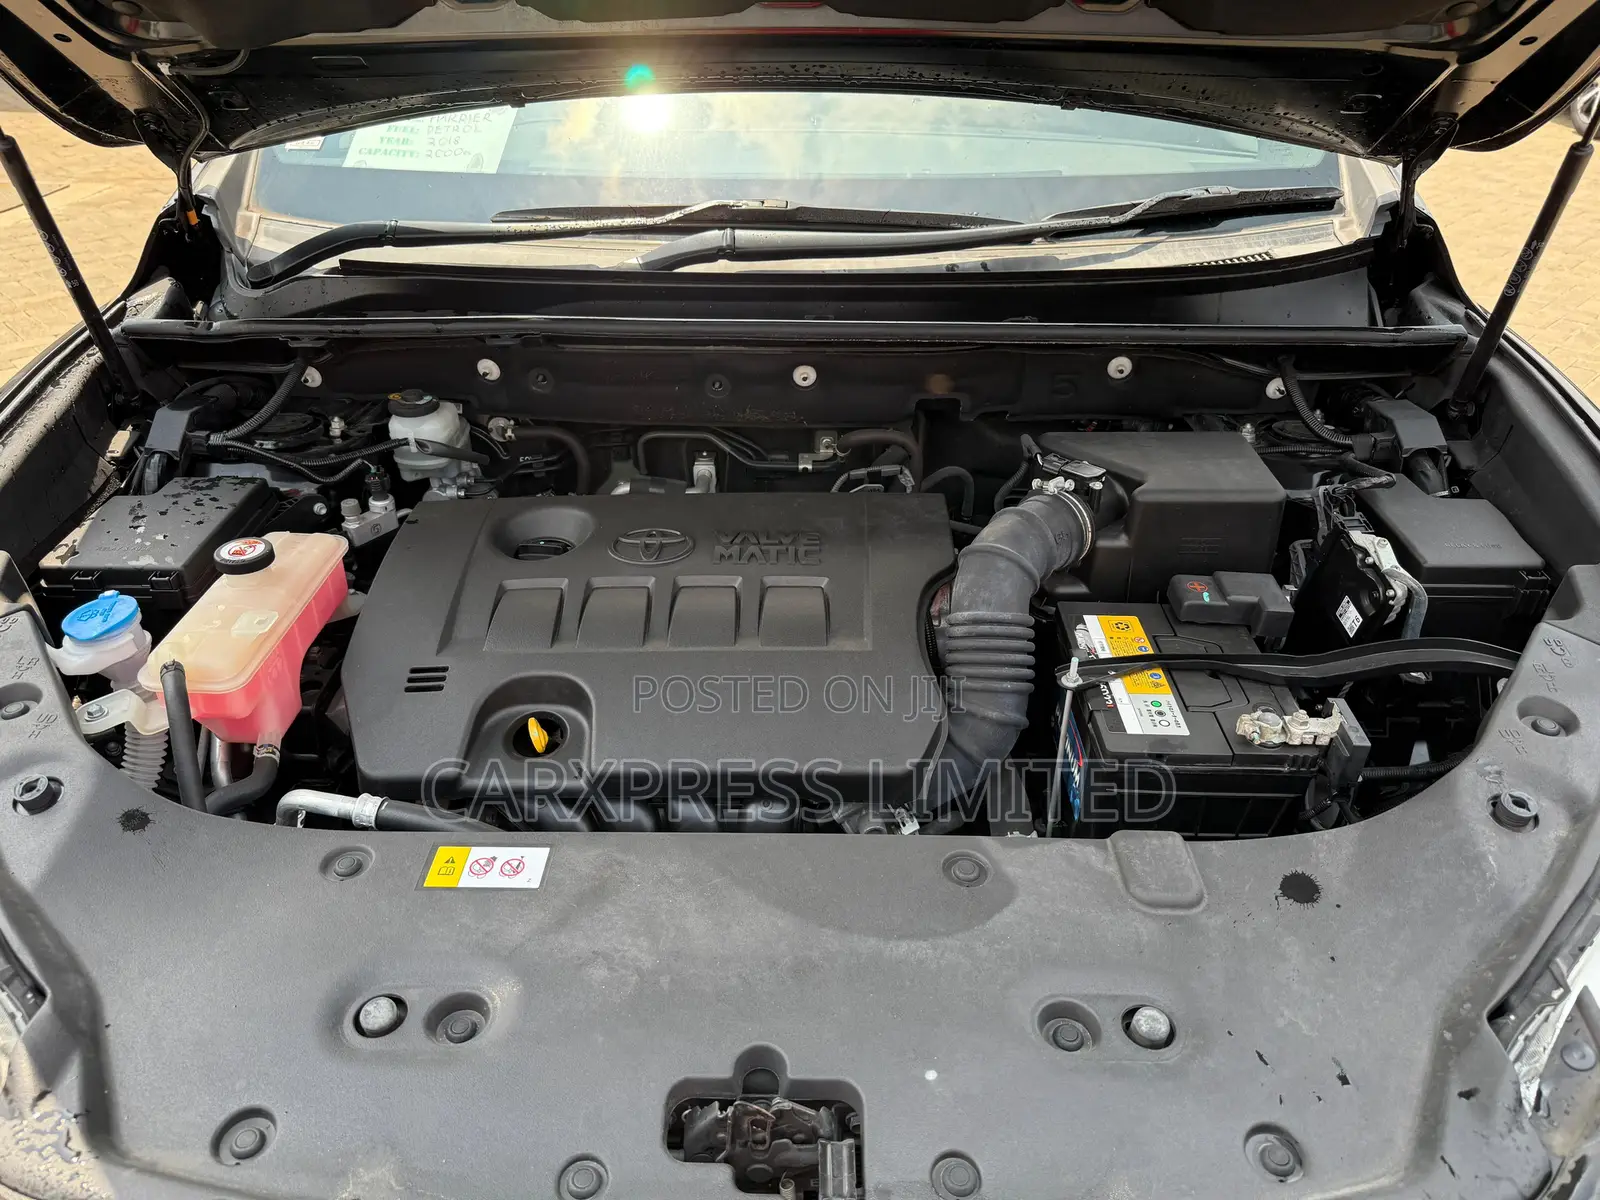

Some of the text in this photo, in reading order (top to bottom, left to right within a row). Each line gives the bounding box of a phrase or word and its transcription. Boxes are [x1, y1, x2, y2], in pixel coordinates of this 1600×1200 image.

[427, 136, 461, 147] 2018
[358, 148, 420, 159] CAPACITY:
[712, 530, 820, 546] VALVE
[712, 545, 821, 566] MATIC
